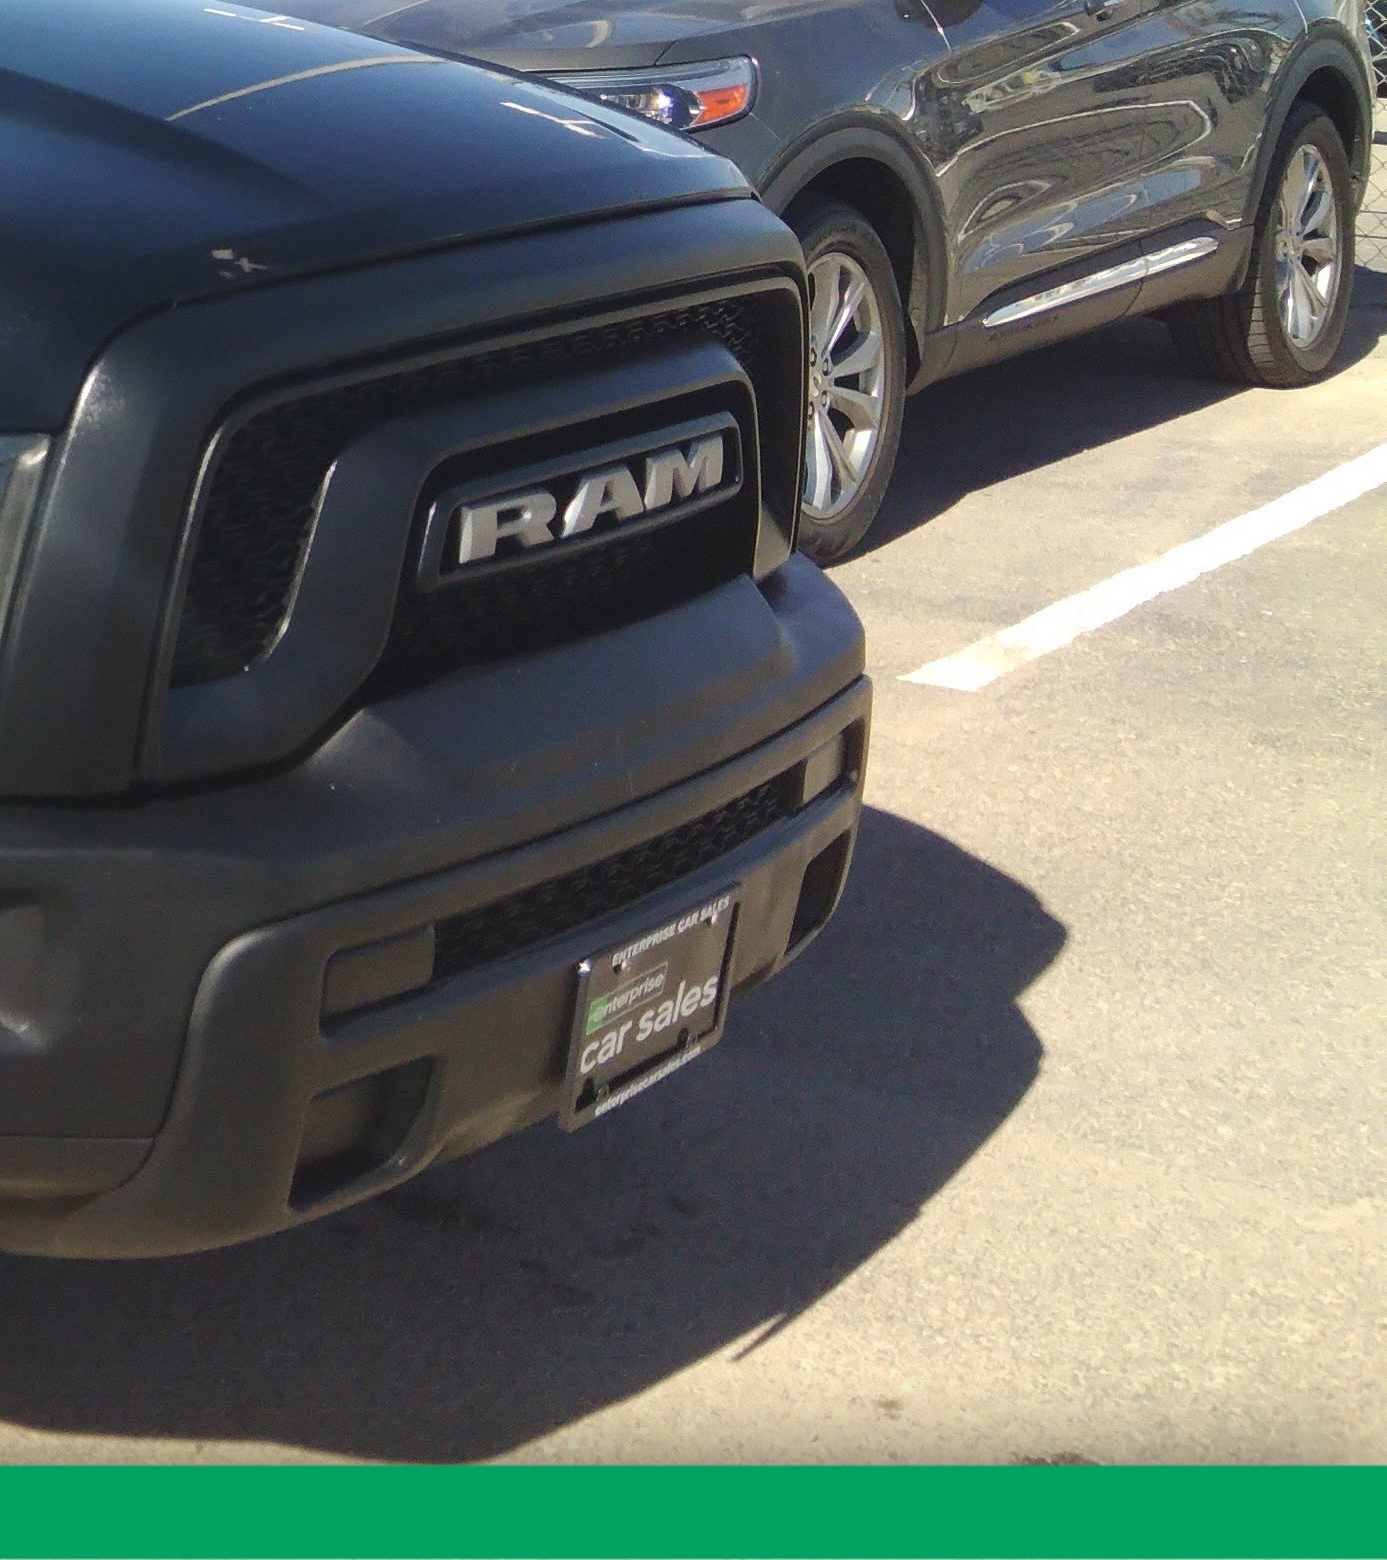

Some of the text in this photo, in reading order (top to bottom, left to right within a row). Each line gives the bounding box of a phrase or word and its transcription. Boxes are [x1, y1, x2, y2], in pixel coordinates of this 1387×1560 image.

[459, 435, 724, 564] RAM
[580, 976, 719, 1075] car sales
[588, 972, 665, 1024] enterprise
